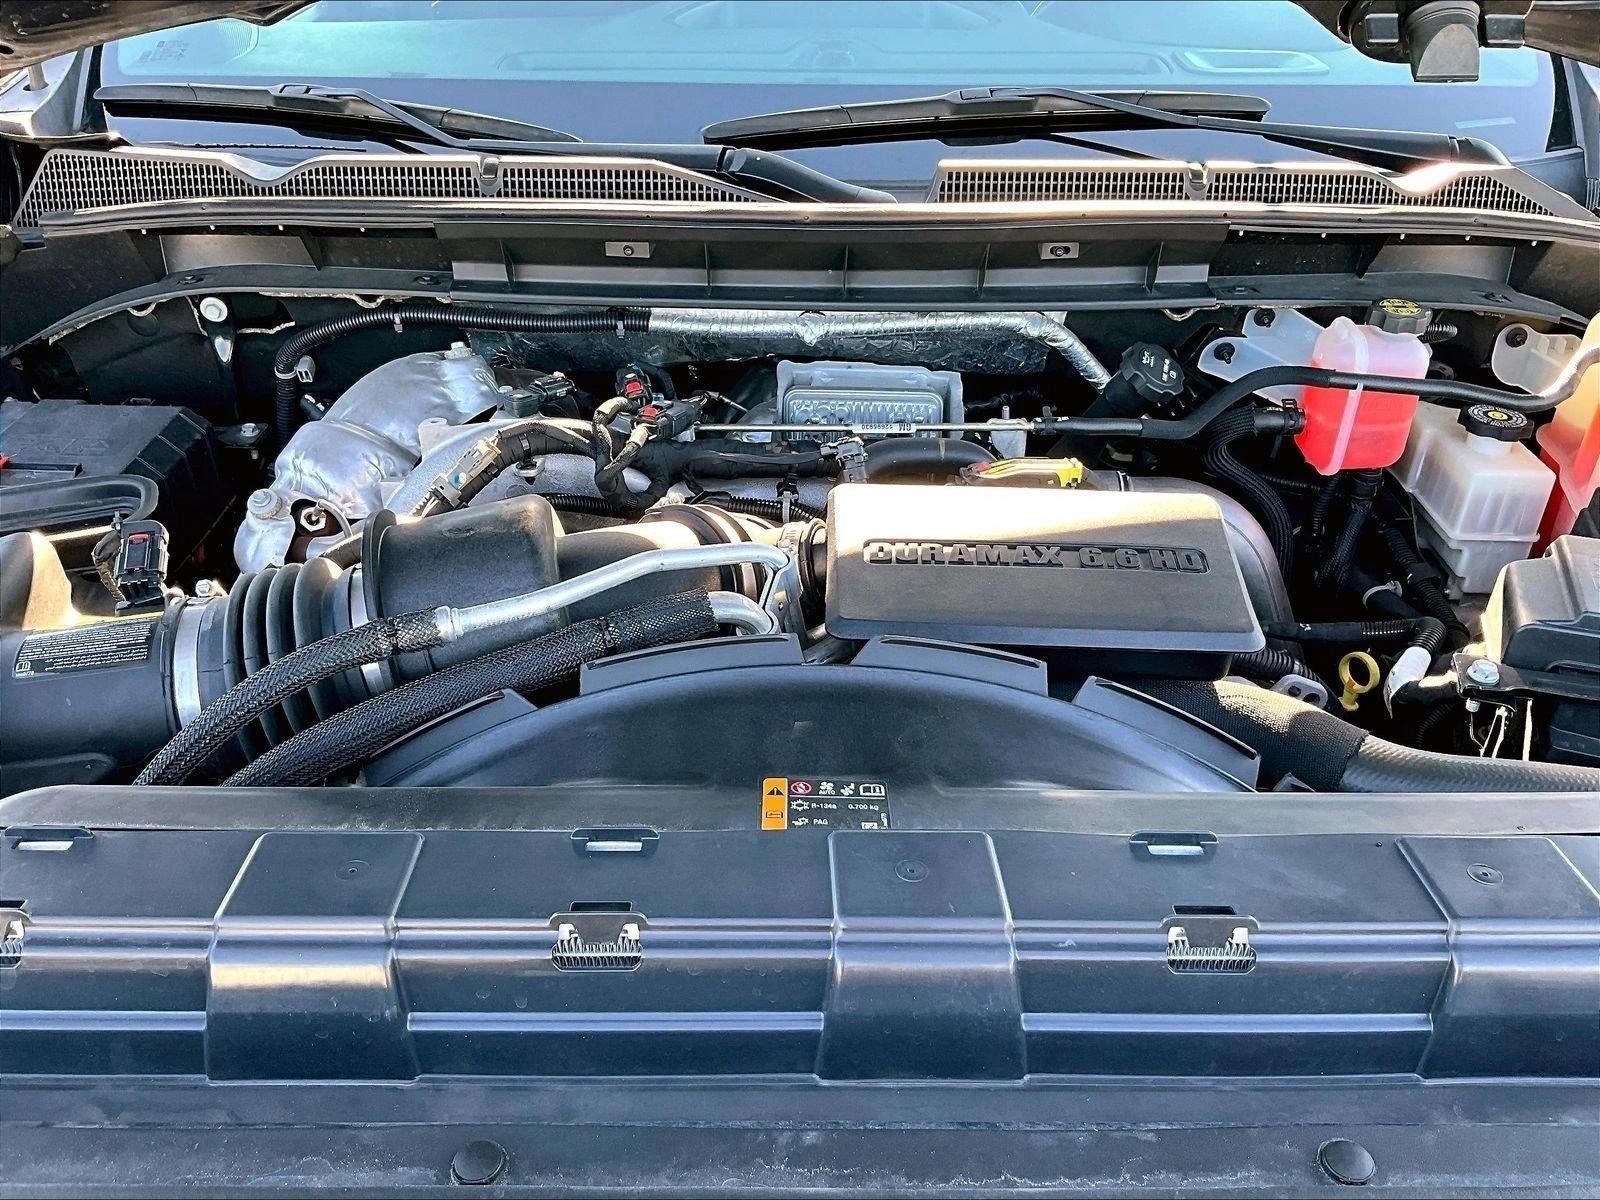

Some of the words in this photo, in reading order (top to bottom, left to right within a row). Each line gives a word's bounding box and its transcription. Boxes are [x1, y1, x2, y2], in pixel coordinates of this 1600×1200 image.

[899, 423, 912, 431] GM
[869, 542, 1062, 566] DURAMAX
[1080, 547, 1141, 569] 6.6
[1149, 550, 1203, 572] HD
[869, 803, 879, 811] kg
